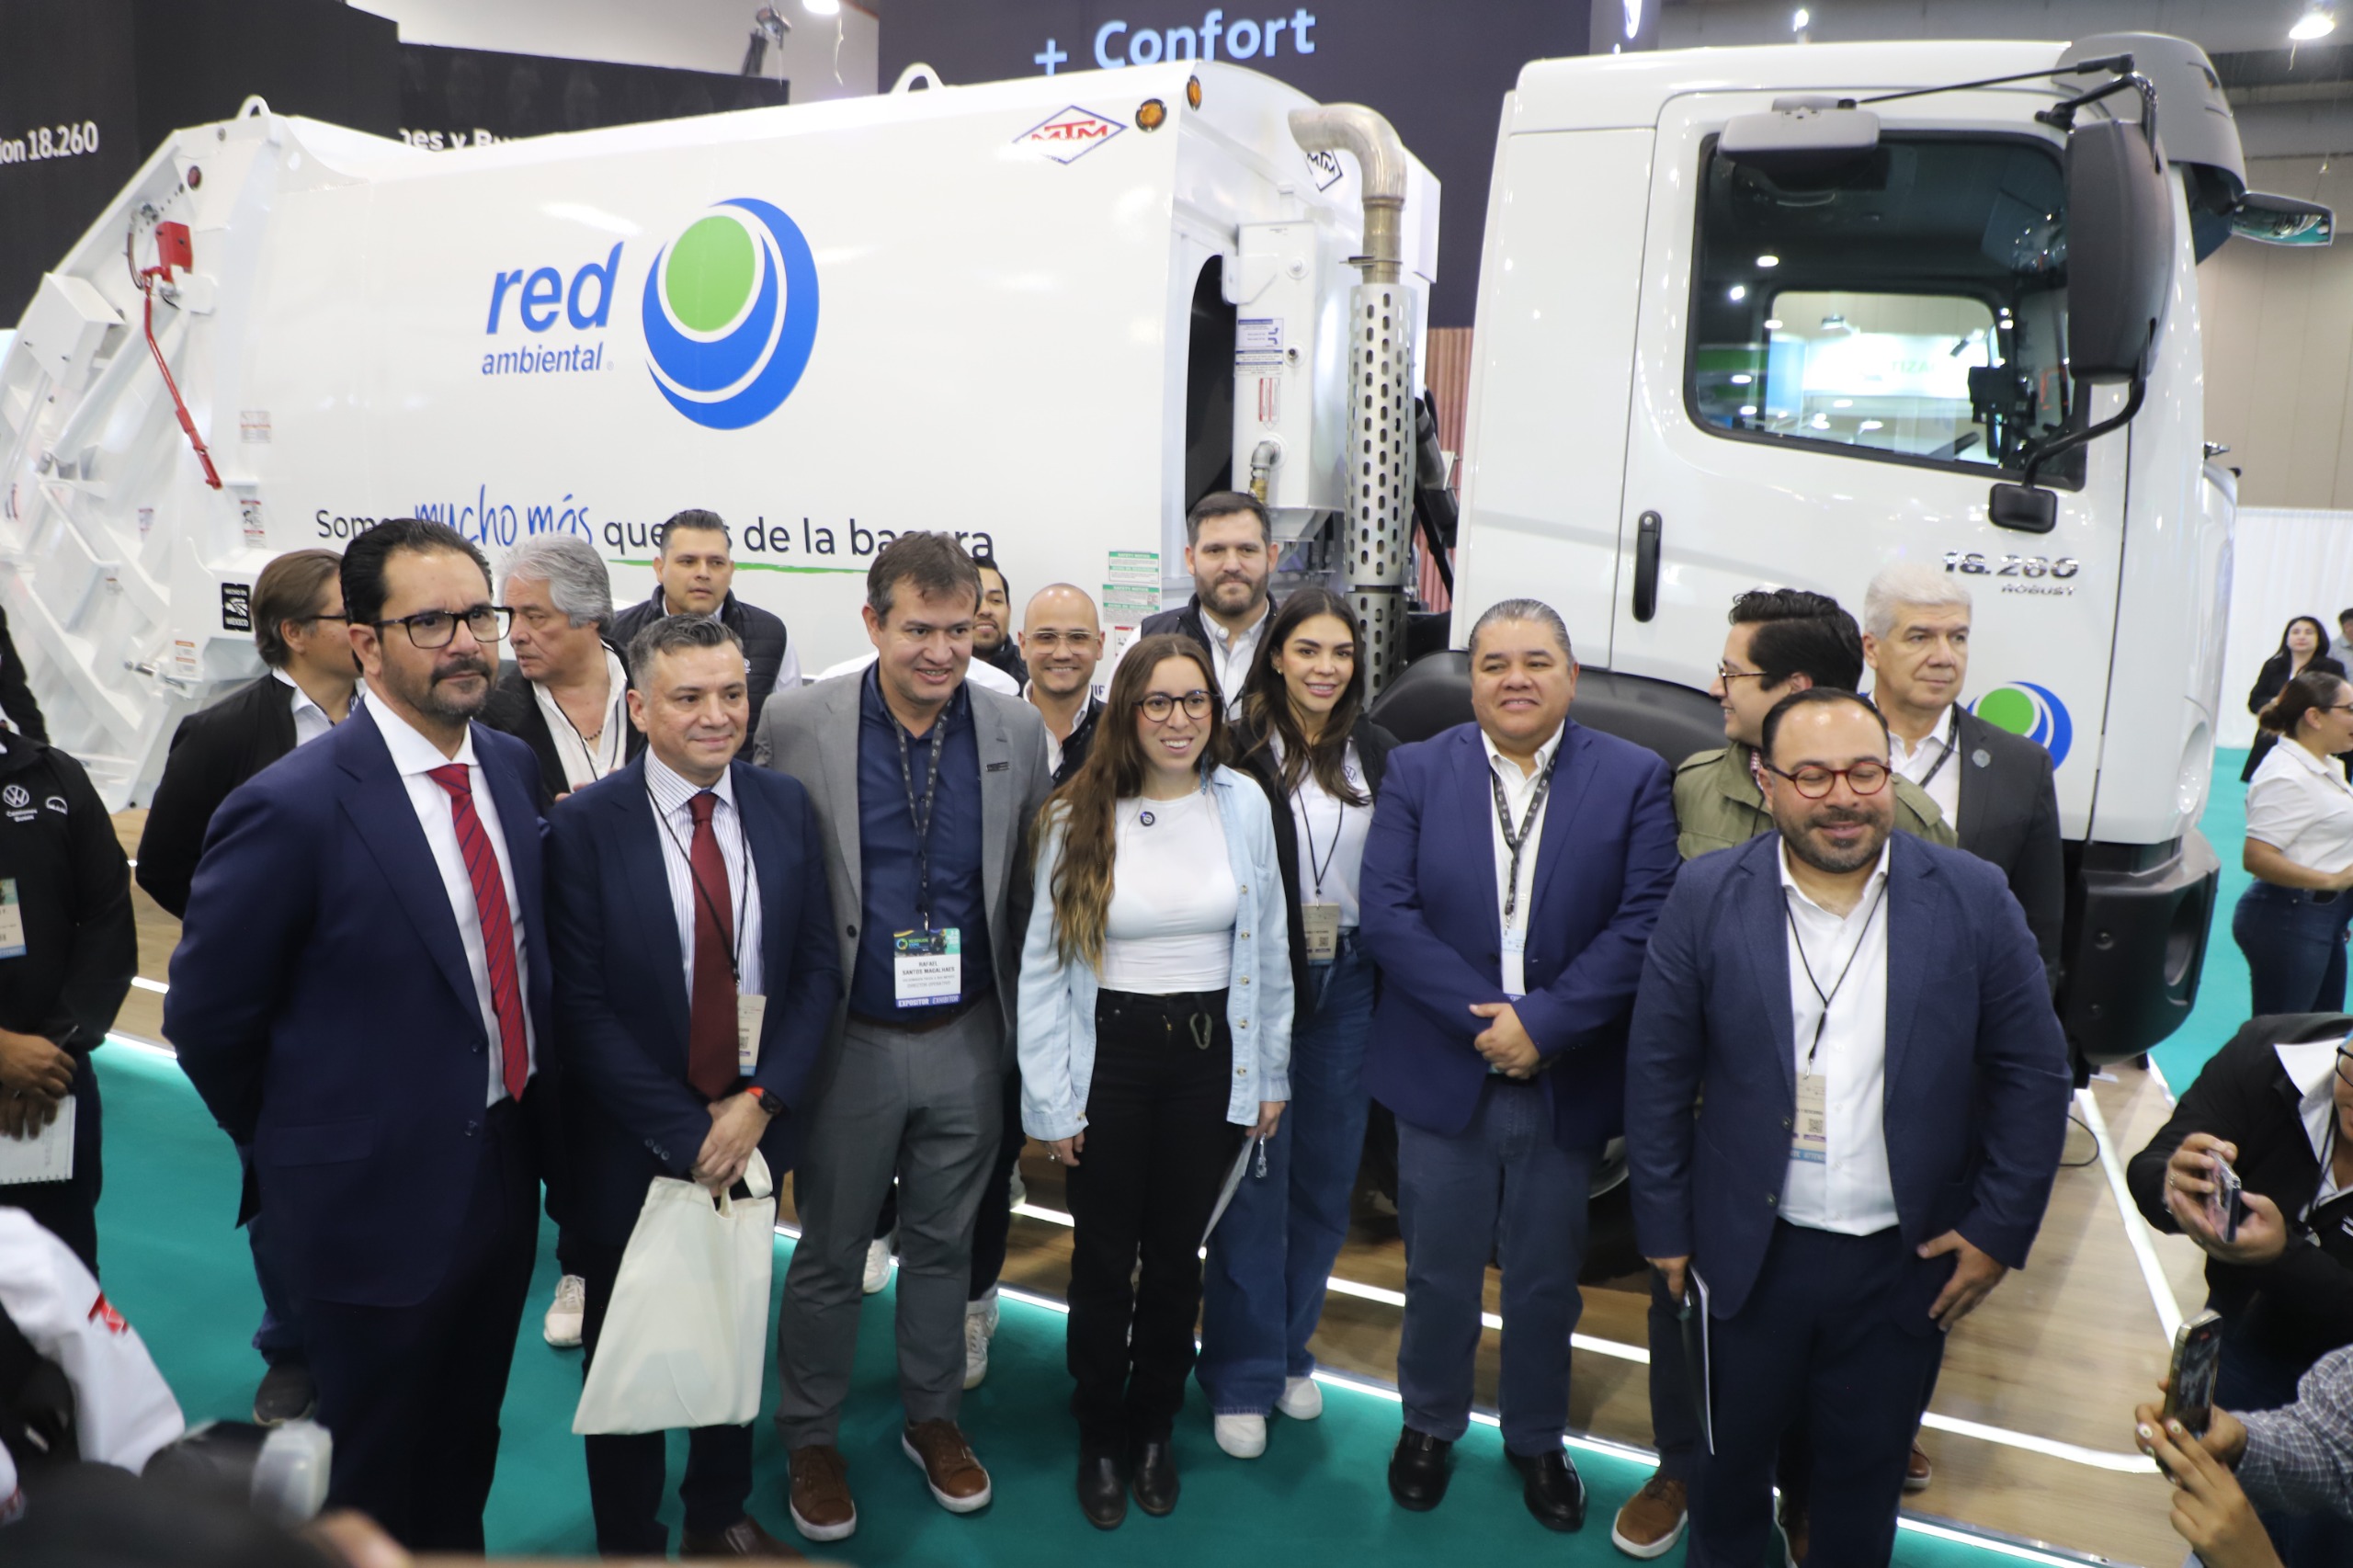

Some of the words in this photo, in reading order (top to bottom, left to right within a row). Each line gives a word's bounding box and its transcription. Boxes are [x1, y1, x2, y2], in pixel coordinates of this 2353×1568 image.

[1094, 8, 1316, 70] Confort
[28, 119, 99, 161] 18.260
[1030, 119, 1108, 142] MTM
[486, 241, 625, 335] red
[482, 341, 604, 376] ambiental
[743, 516, 791, 553] de
[802, 517, 836, 555] la
[848, 517, 995, 561] bara
[898, 998, 929, 1008] EXPOSITOR
[932, 994, 960, 1005] EXHIBITOR
